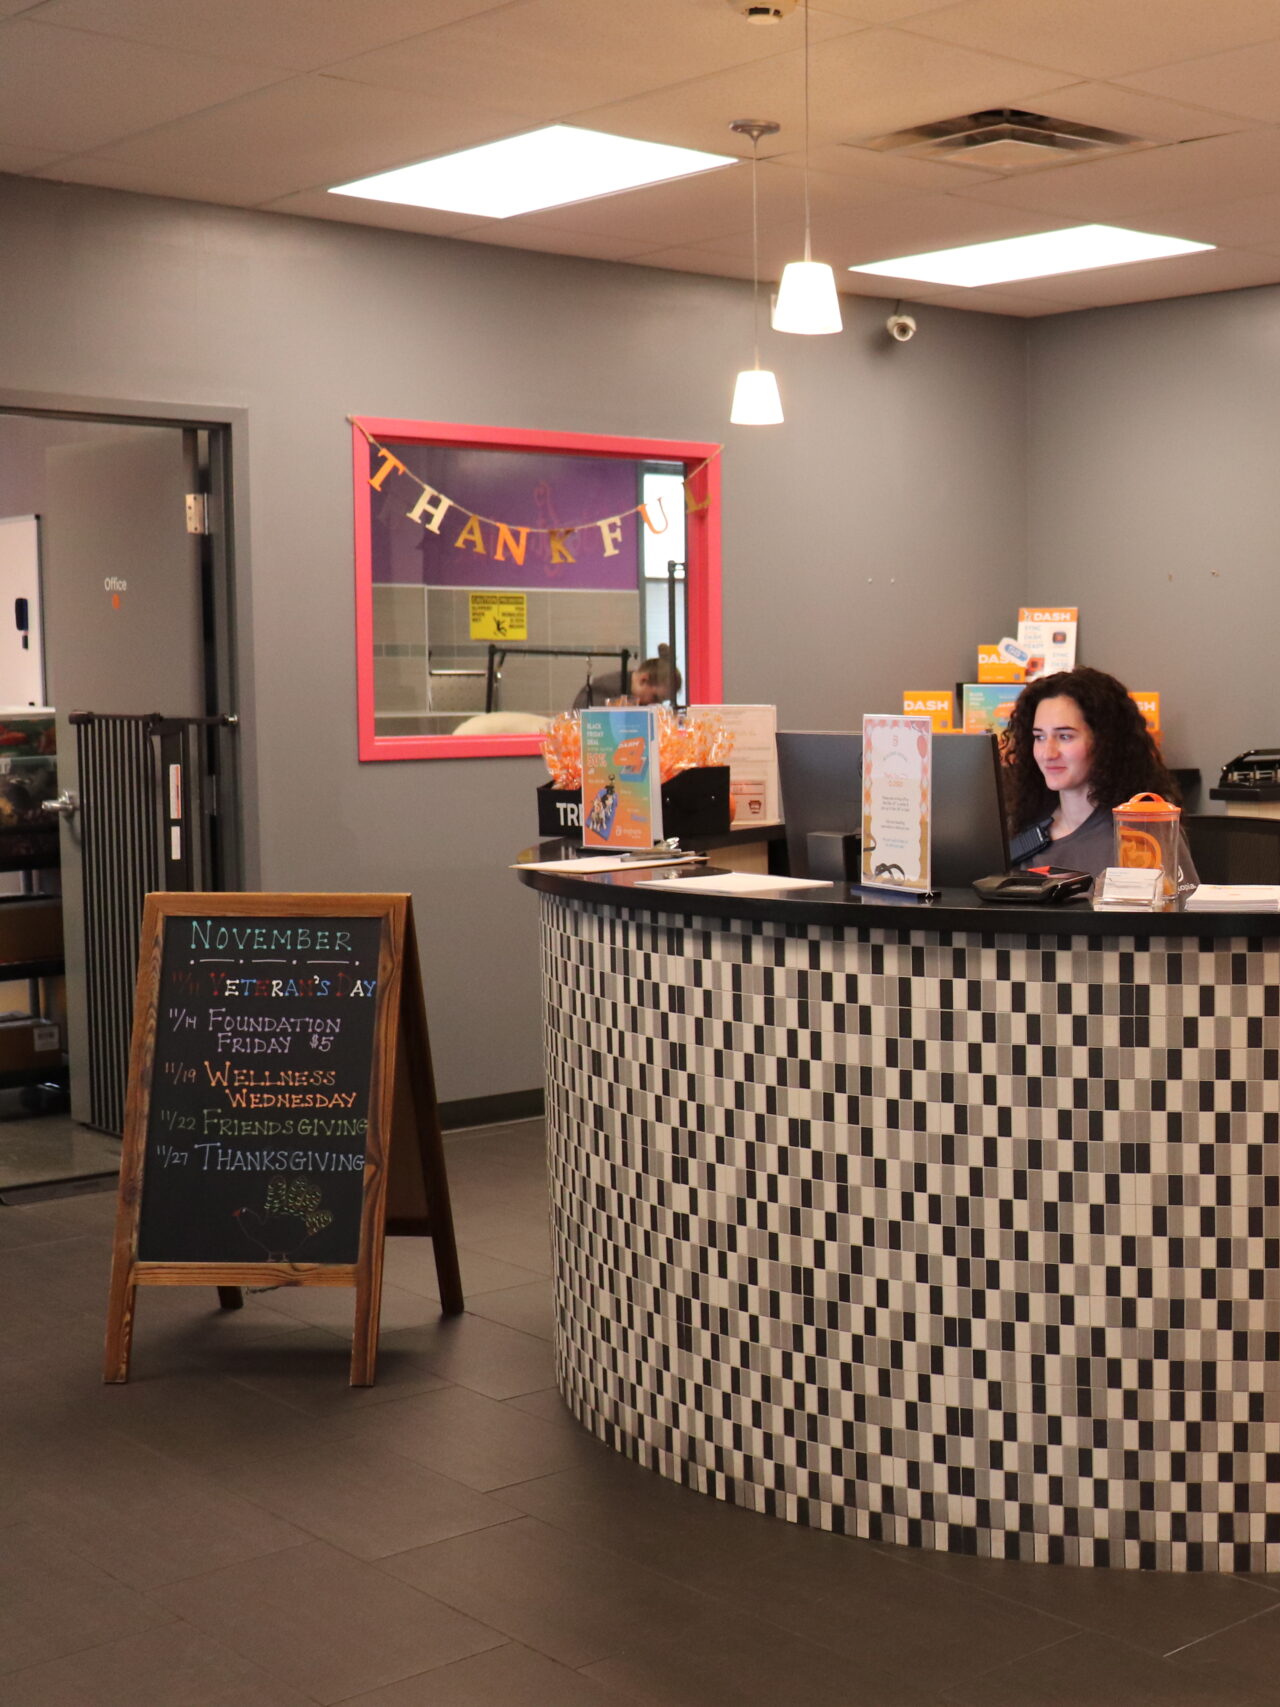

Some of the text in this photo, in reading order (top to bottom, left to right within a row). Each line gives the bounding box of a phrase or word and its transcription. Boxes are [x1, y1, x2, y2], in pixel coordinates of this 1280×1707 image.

[104, 576, 127, 591] Office
[1033, 612, 1071, 621] DASH
[978, 654, 1013, 664] DAS
[904, 700, 949, 711] DASH
[191, 920, 352, 951] NOVEMBER
[209, 971, 331, 997] VETERAN'S
[335, 971, 377, 997] DAY
[169, 1007, 341, 1033] 11/14 FOUNDATION
[217, 1032, 335, 1053] FRIDAY $5
[165, 1060, 336, 1087] 11/19 WELLNESS
[225, 1088, 357, 1109] WEDNESDAY
[160, 1109, 196, 1131] 11/22
[157, 1142, 366, 1171] 11/27 THANKSGIVING
